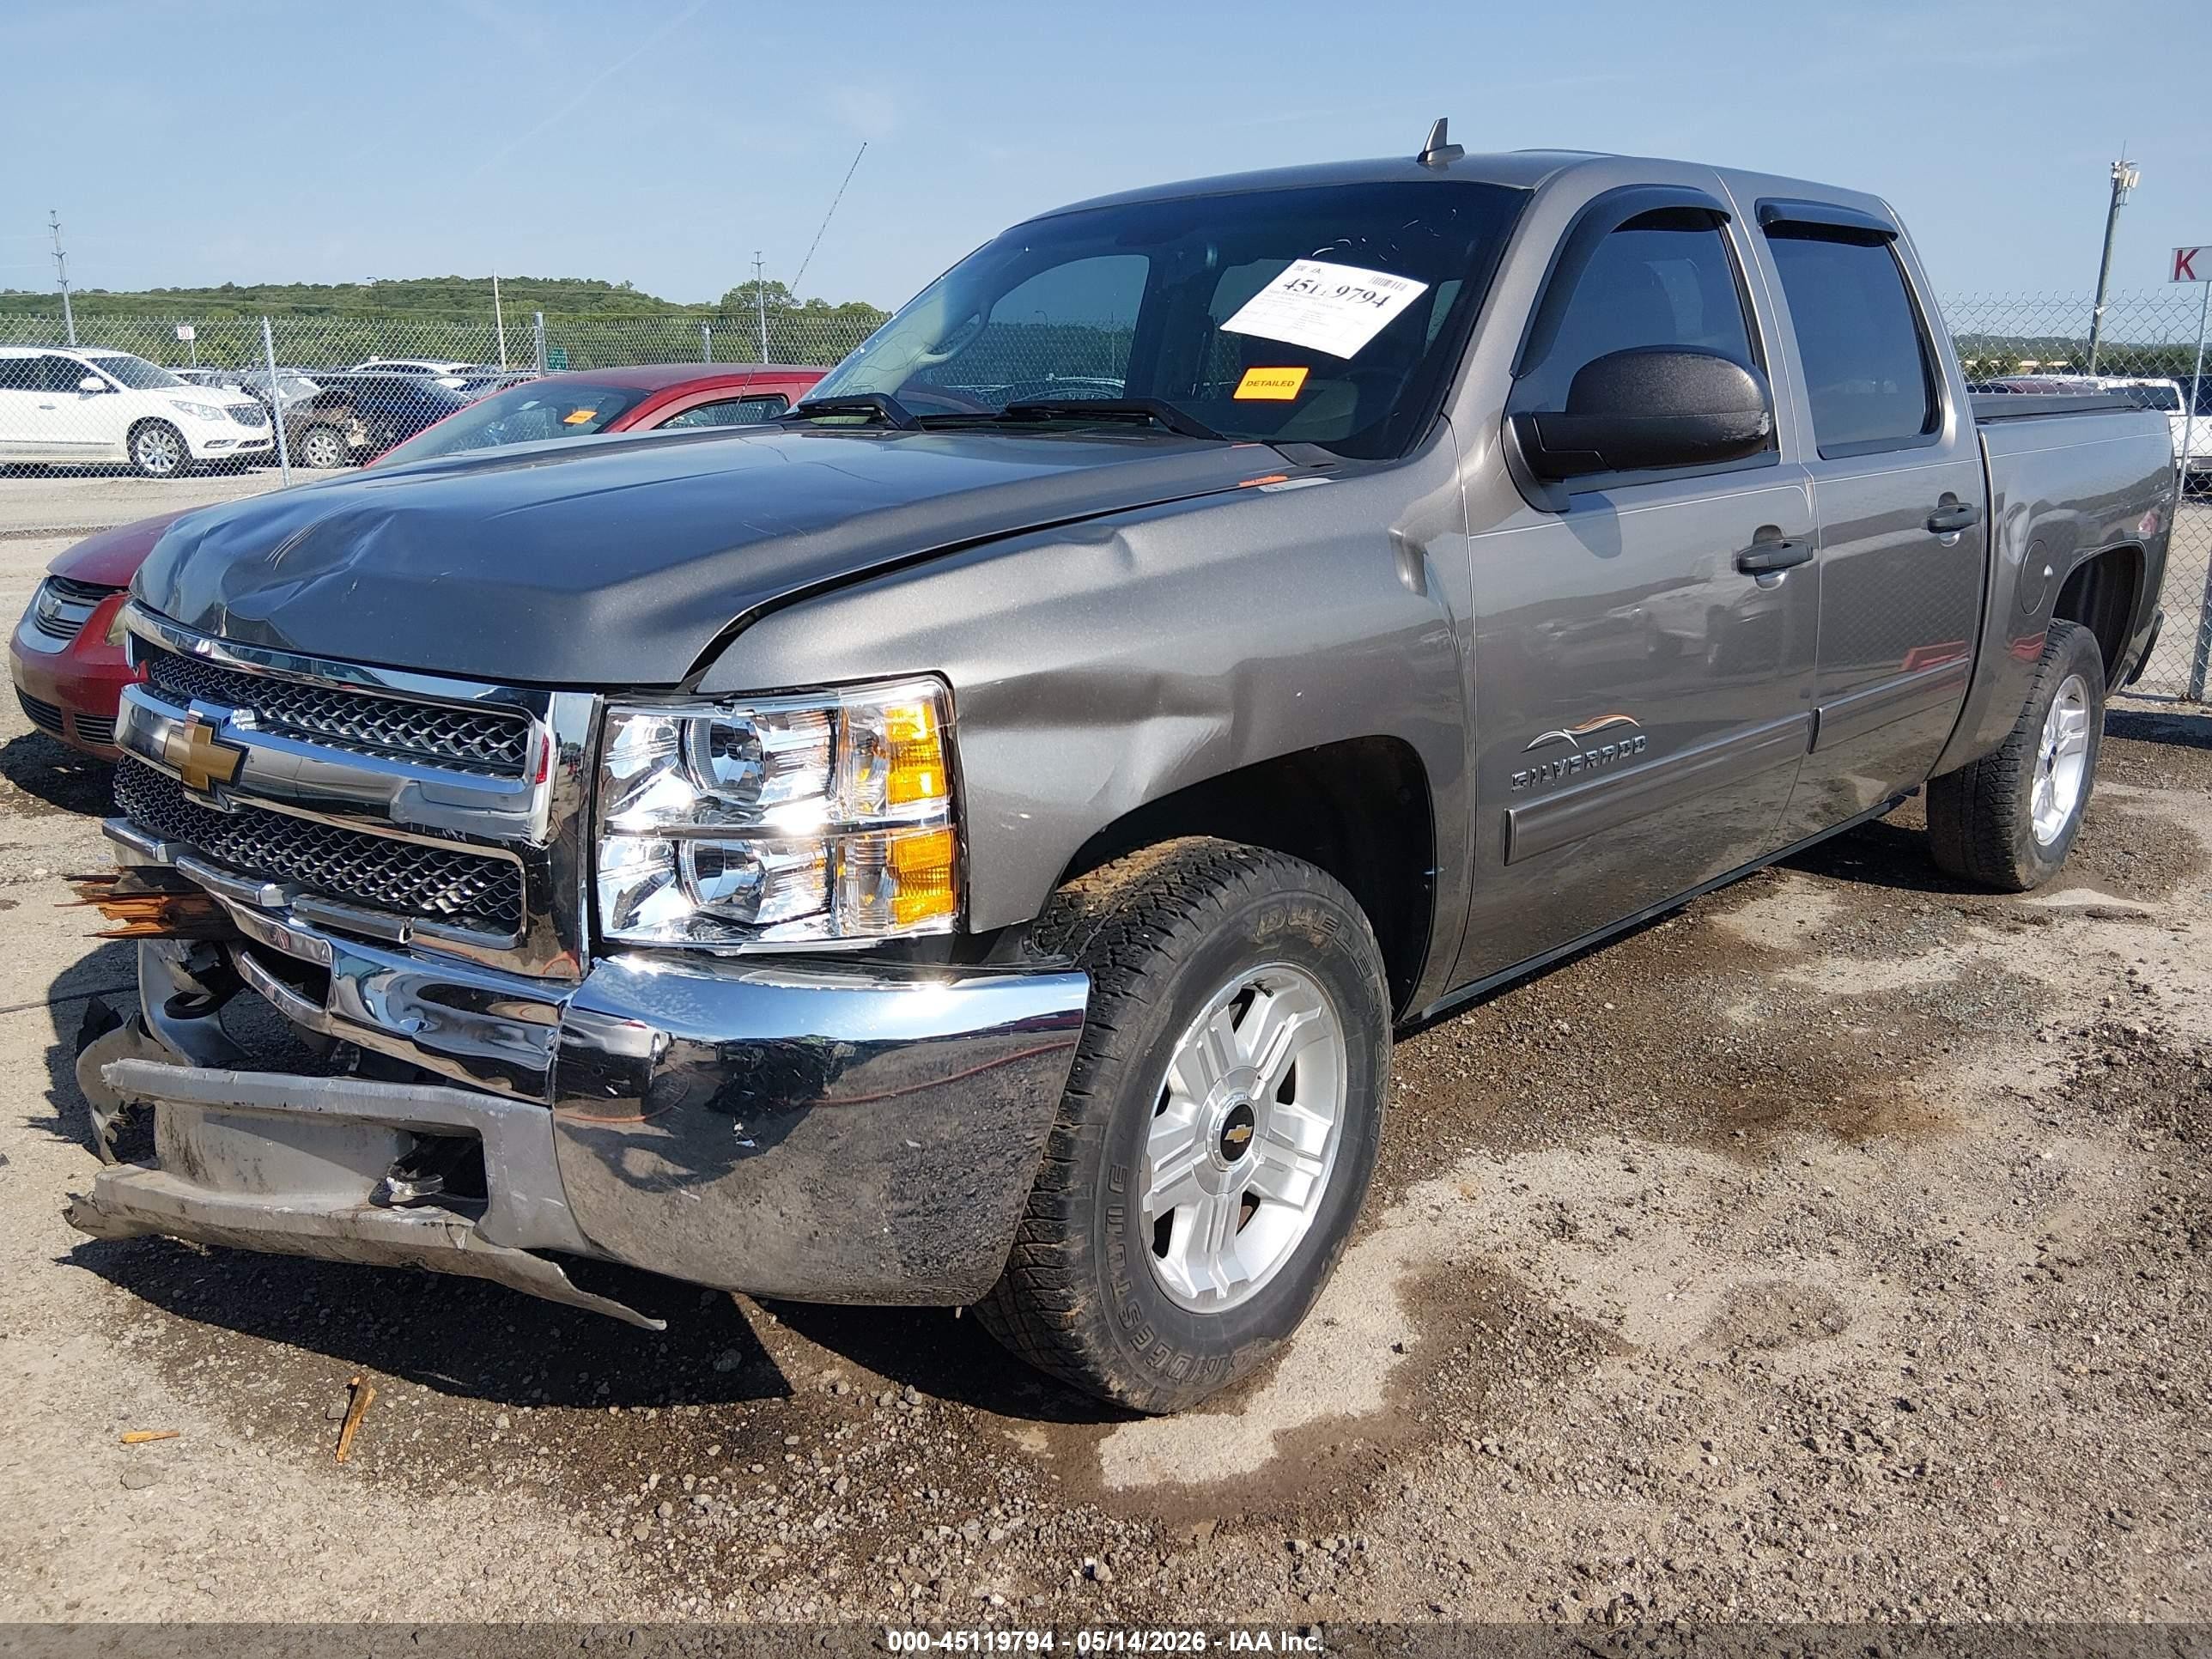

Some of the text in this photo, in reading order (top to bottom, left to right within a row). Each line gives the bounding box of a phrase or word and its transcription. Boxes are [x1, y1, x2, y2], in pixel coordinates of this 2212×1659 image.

[2173, 248, 2199, 282] K
[1511, 735, 1646, 792] SILVERADO
[1104, 1164, 1255, 1382] BRIDGESTONE
